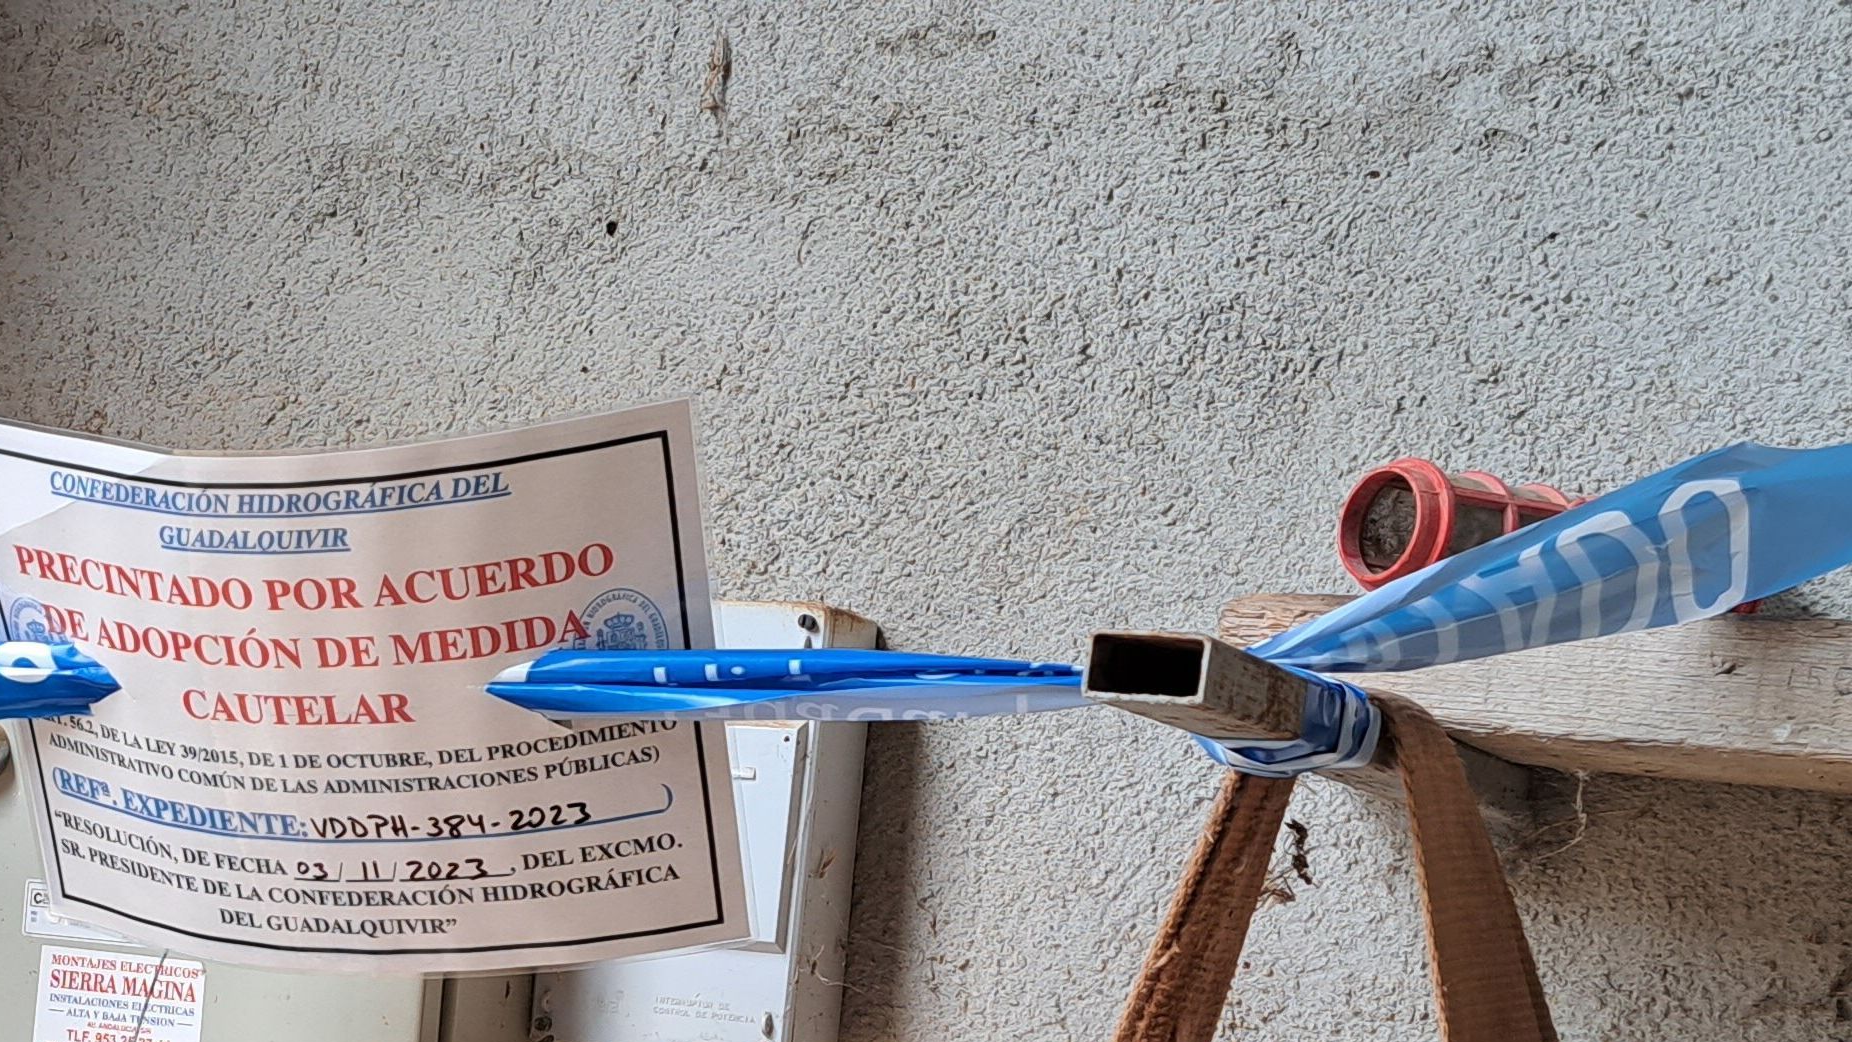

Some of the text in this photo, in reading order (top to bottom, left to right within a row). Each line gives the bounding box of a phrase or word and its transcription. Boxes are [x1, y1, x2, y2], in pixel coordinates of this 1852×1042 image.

[50, 471, 510, 514] CONFEDERACIÓN HIDROGRÁFICA DEL
[159, 526, 348, 552] GUADALQUIVIR
[13, 543, 614, 611] PRECINTADO POR ACUERDO
[41, 604, 89, 642] DE
[97, 617, 302, 669] ADOPCIÓN
[313, 636, 379, 668] DE
[388, 609, 591, 666] MEDIDA
[182, 689, 416, 726] CAUTELAR
[49, 733, 661, 794] ADMINISTRATIVO COMÚN DE LAS ADMINISTRACIONES PÚBLICAS)
[100, 724, 121, 743] DE
[124, 731, 143, 750] LA
[146, 737, 176, 757] LEY
[180, 744, 244, 768] 39/2015,
[248, 751, 275, 768] DE
[280, 753, 289, 768] 1
[292, 754, 322, 769] DE
[326, 751, 433, 769] OCTUBRE,
[438, 748, 482, 766] DEL
[487, 720, 677, 761] PROCEDIMIENTO
[121, 787, 308, 838] EXPEDIENTE:
[60, 838, 680, 907] SR. PRESIDENTE DE LA CONFEDERACIÓN HIDROGRÁFICA
[181, 847, 211, 867] DE
[214, 852, 288, 875] FECHA
[521, 849, 574, 871] DEL
[579, 833, 683, 864] EXCMO.
[220, 908, 263, 931] DEL
[51, 954, 117, 971] MONTAJES
[50, 968, 196, 1002] SIERRA MAGINA
[49, 993, 195, 1017] INSTALACIONES ELCTRICAS
[66, 1009, 90, 1020] ALTA
[93, 1010, 99, 1019] Y
[66, 1029, 91, 1042] TLF.
